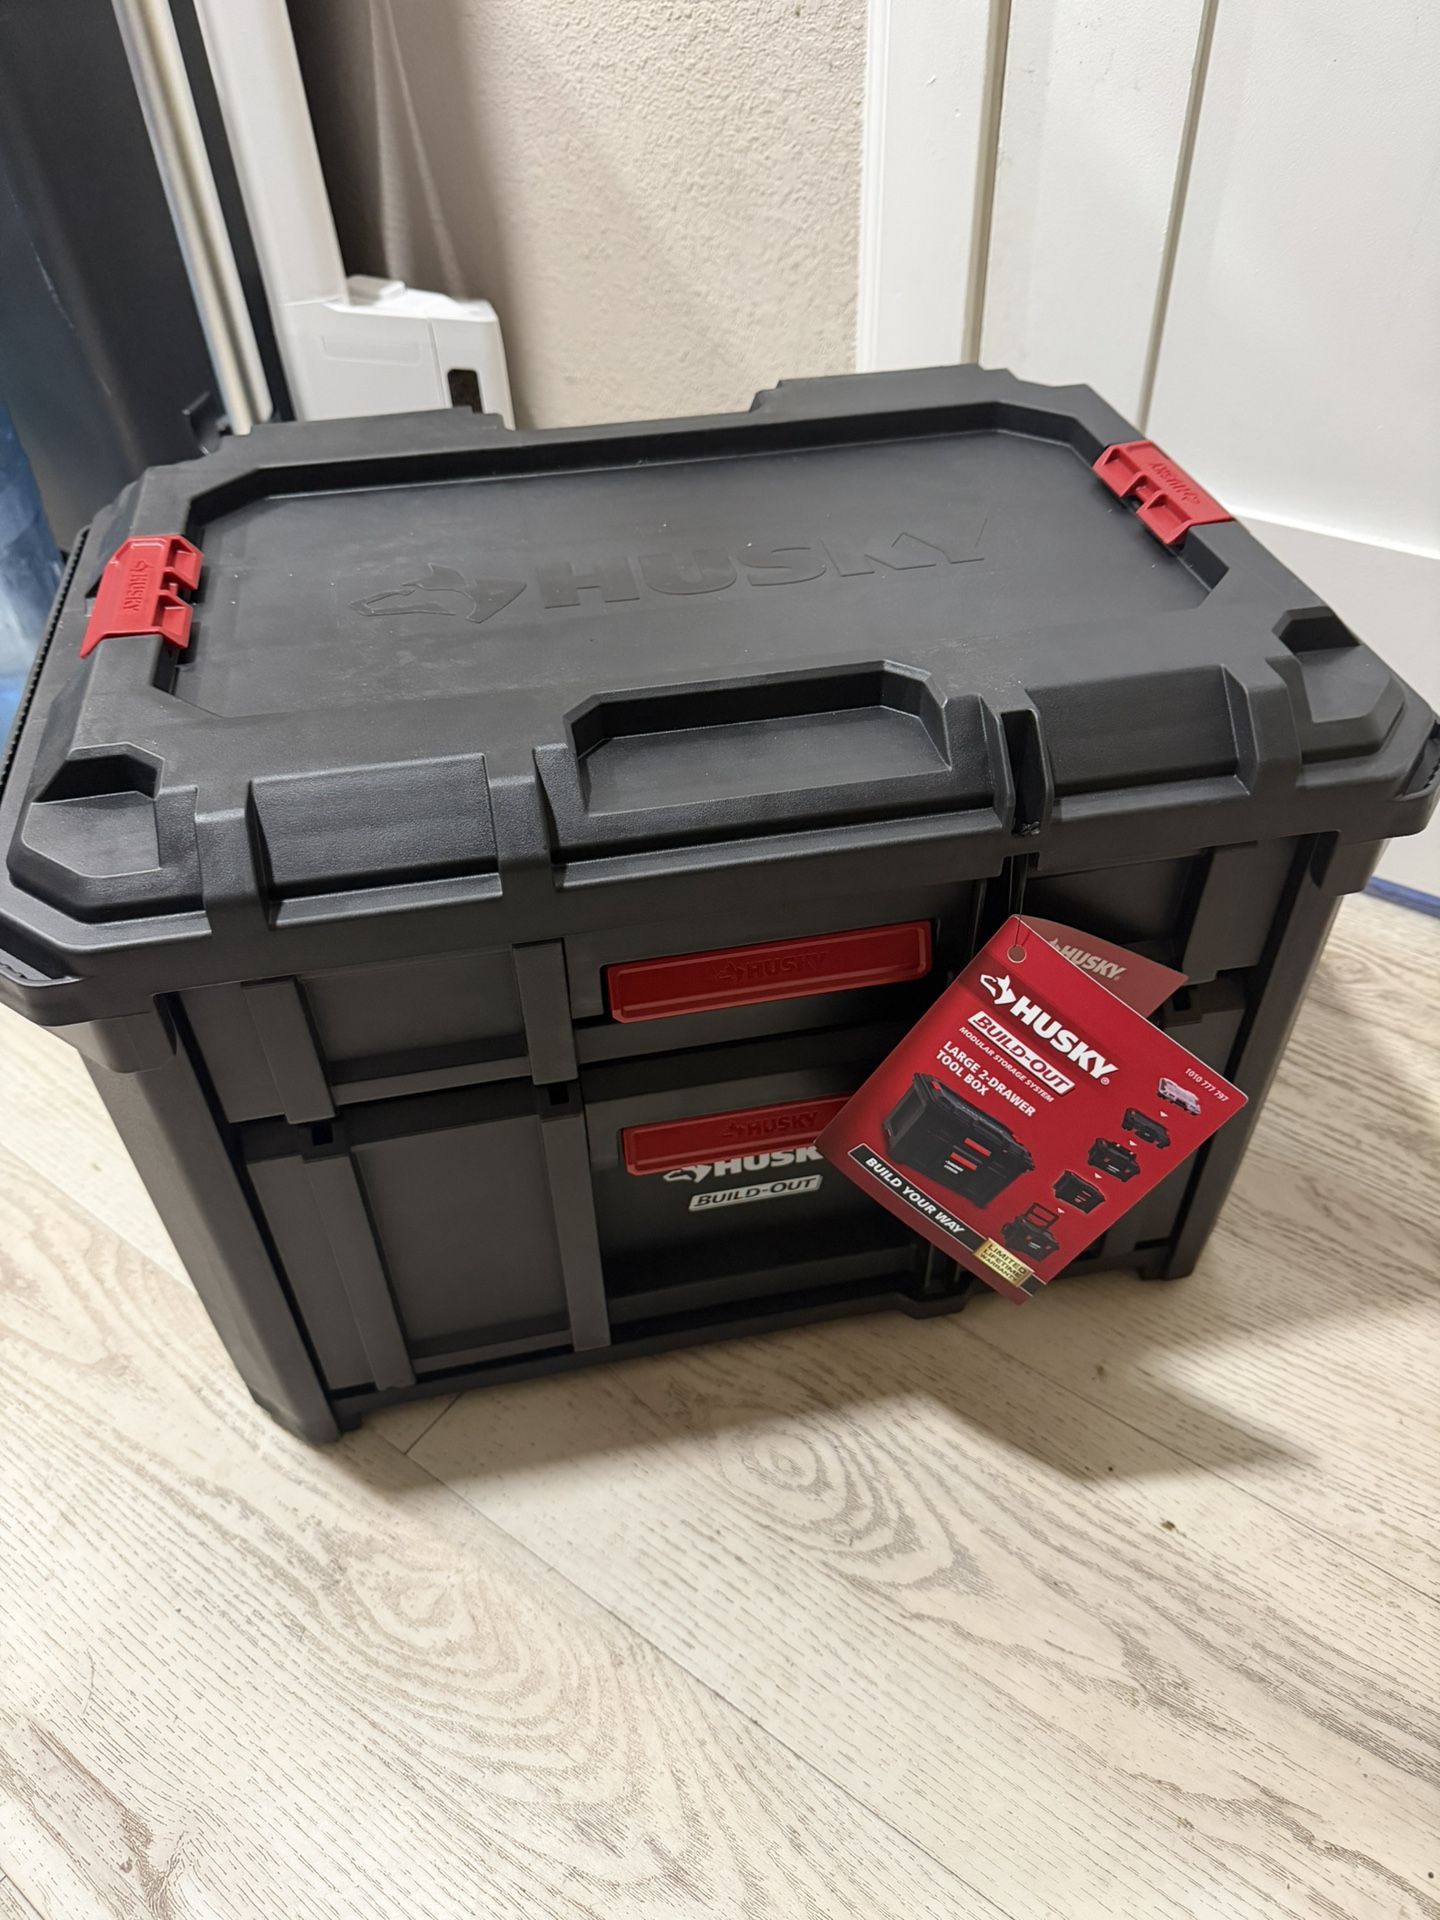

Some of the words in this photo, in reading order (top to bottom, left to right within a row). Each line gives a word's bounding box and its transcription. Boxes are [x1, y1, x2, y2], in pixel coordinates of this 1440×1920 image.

[537, 516, 989, 609] HUSKY
[746, 952, 823, 978] HUSKY
[958, 1026, 994, 1057] MODULAR
[993, 1051, 1027, 1082] STORAGE
[1025, 1075, 1055, 1103] SYSTEM
[973, 1015, 1072, 1093] BUILD-OUT
[935, 1051, 964, 1078] TOOL
[961, 1069, 990, 1097] BOX
[943, 1041, 981, 1075] LARGE
[980, 1068, 1037, 1118] 2-DRAWER
[1185, 1068, 1203, 1084] 1010
[1201, 1080, 1217, 1092] 777
[1214, 1089, 1230, 1102] 797
[750, 1111, 818, 1137] HUSKY
[713, 1145, 824, 1177] HUSK
[696, 1177, 817, 1207] BUILD-OUT
[865, 1156, 903, 1188] BUILD
[902, 1185, 937, 1215] YOUR
[934, 1210, 965, 1234] WAY
[983, 1249, 1022, 1279] LIFETIME
[987, 1243, 1027, 1274] LIMITED
